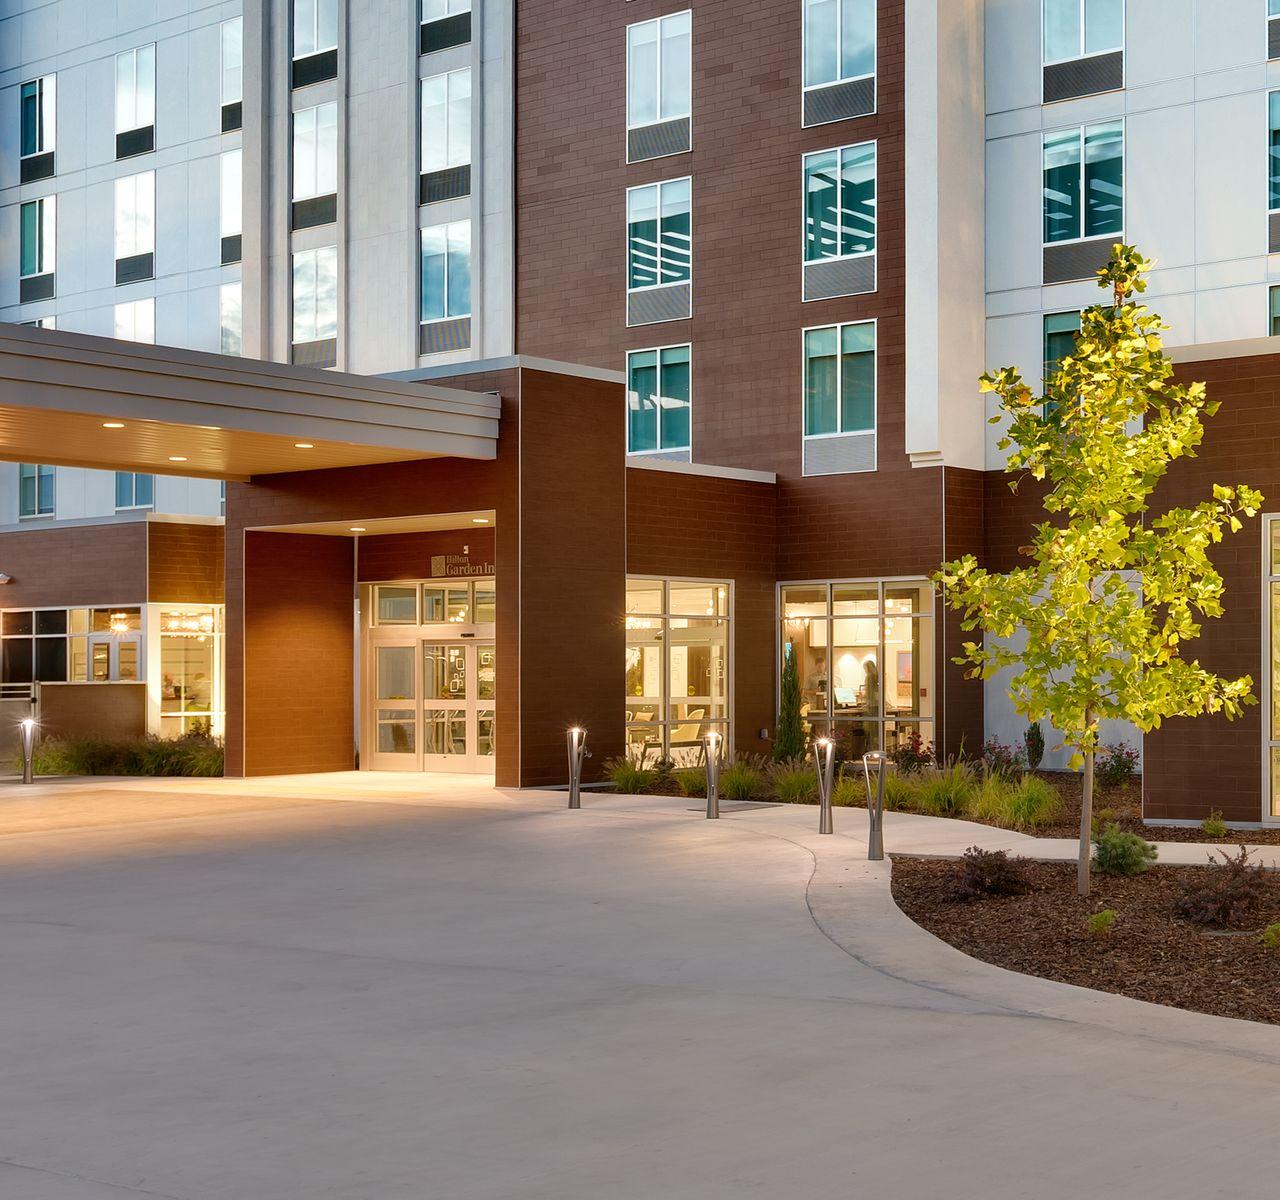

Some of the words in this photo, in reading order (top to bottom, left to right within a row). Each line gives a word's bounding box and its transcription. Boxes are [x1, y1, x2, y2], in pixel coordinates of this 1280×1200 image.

[446, 555, 469, 563] Hilton
[446, 563, 482, 575] Garden
[484, 562, 496, 574] In
